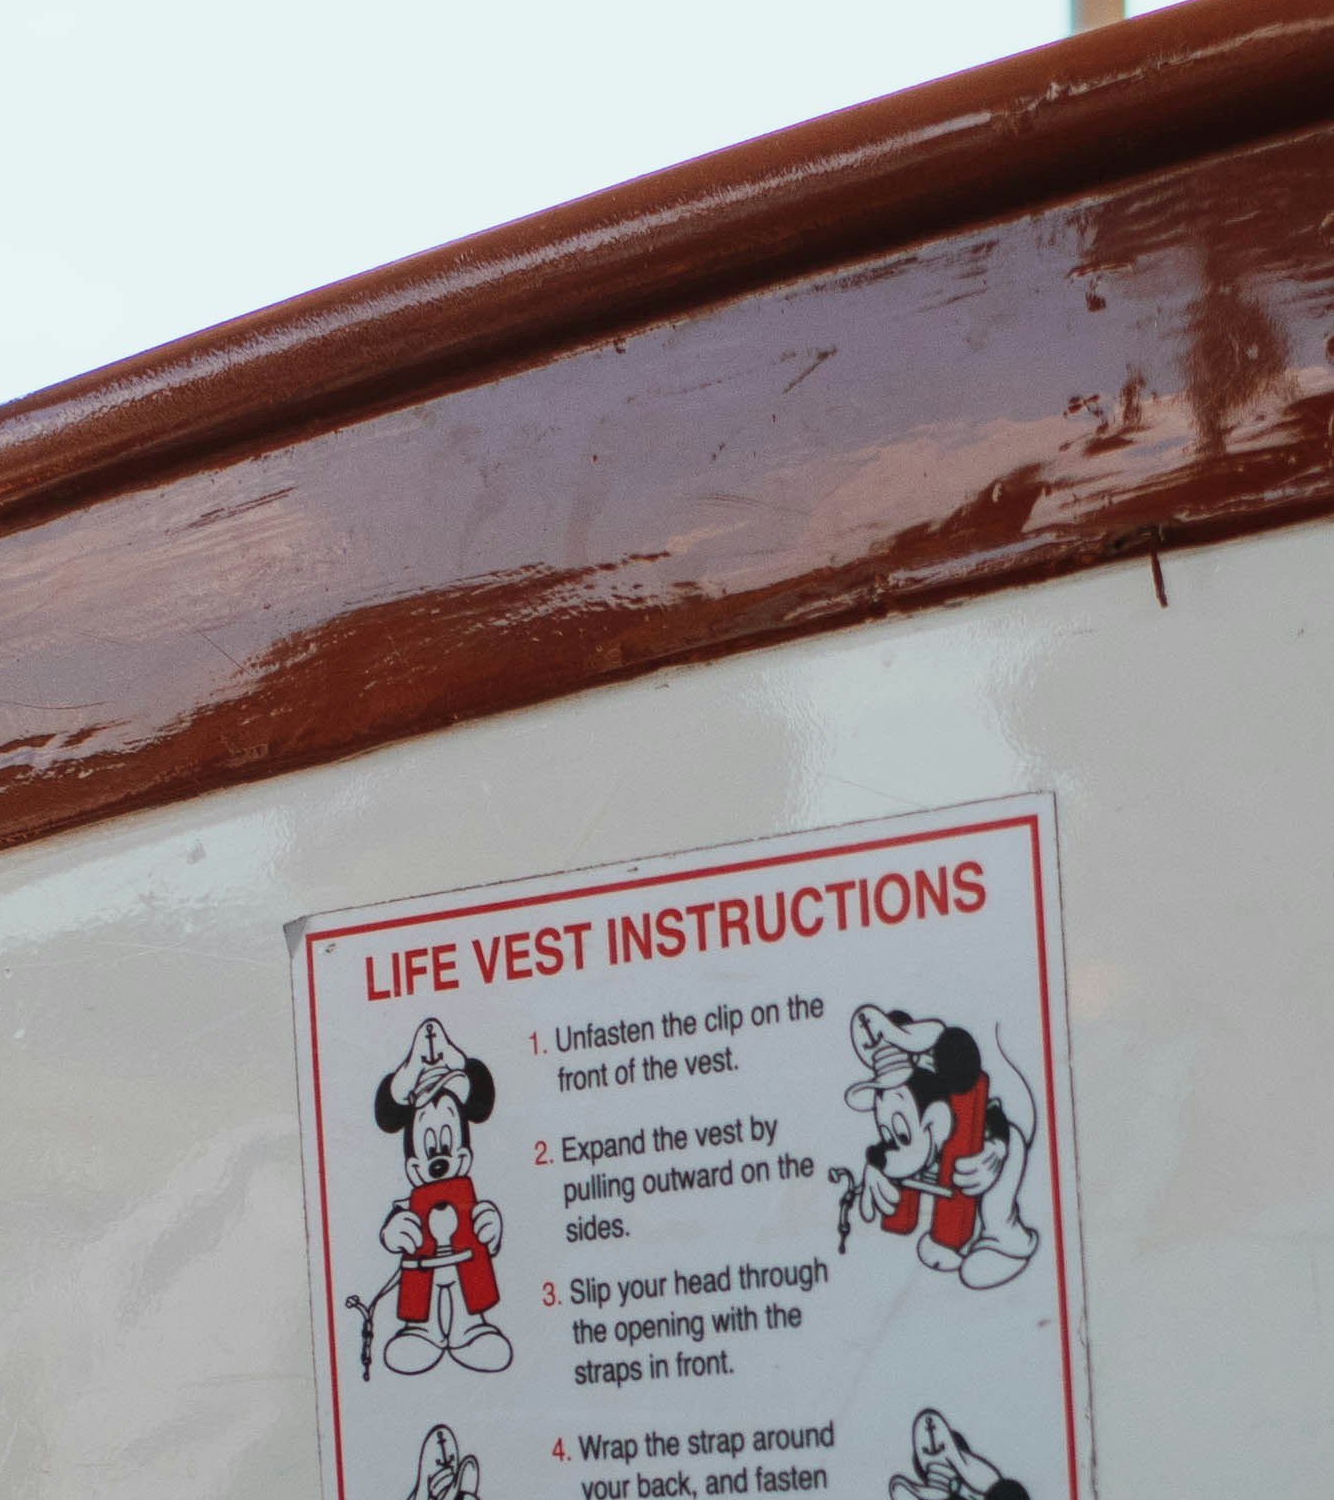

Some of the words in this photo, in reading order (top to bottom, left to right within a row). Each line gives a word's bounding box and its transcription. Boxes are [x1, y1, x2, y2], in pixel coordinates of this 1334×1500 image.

[365, 943, 460, 1002] LIFE
[471, 922, 592, 984] VEST
[606, 860, 986, 966] INSTRUCTIONS
[529, 1031, 548, 1056] 1.
[555, 1019, 655, 1053] Unfasten
[661, 1011, 697, 1038] the
[704, 1003, 744, 1036] clip
[750, 1003, 780, 1027] on
[787, 994, 824, 1022] the
[557, 1063, 609, 1093] front
[614, 1057, 636, 1085] of
[642, 1055, 678, 1082] the
[684, 1046, 739, 1076] vest.
[534, 1140, 554, 1166] 2.
[561, 1128, 646, 1166] Expand
[652, 1125, 688, 1153] the
[694, 1118, 744, 1147] vest
[750, 1115, 778, 1147] by
[563, 1173, 636, 1210] pulling
[642, 1159, 734, 1195] outward
[741, 1161, 770, 1184] on
[777, 1152, 815, 1180] the
[566, 1214, 630, 1243] sides.
[542, 1281, 562, 1307] 3.
[570, 1277, 611, 1309] Slip
[617, 1277, 667, 1308] your
[674, 1265, 731, 1295] head
[738, 1257, 829, 1292] through
[572, 1318, 607, 1345] the
[614, 1311, 705, 1347] opening
[711, 1305, 758, 1333] with
[764, 1302, 802, 1330] the
[574, 1360, 643, 1389] straps
[649, 1353, 669, 1379] in
[675, 1350, 734, 1377] front.
[551, 1437, 572, 1461] 4.
[578, 1434, 638, 1465] Wrap
[644, 1431, 680, 1458] the
[687, 1429, 745, 1459] strap
[752, 1420, 835, 1452] around
[636, 1470, 697, 1500] back,
[705, 1467, 748, 1496] and
[754, 1465, 828, 1493] fasten
